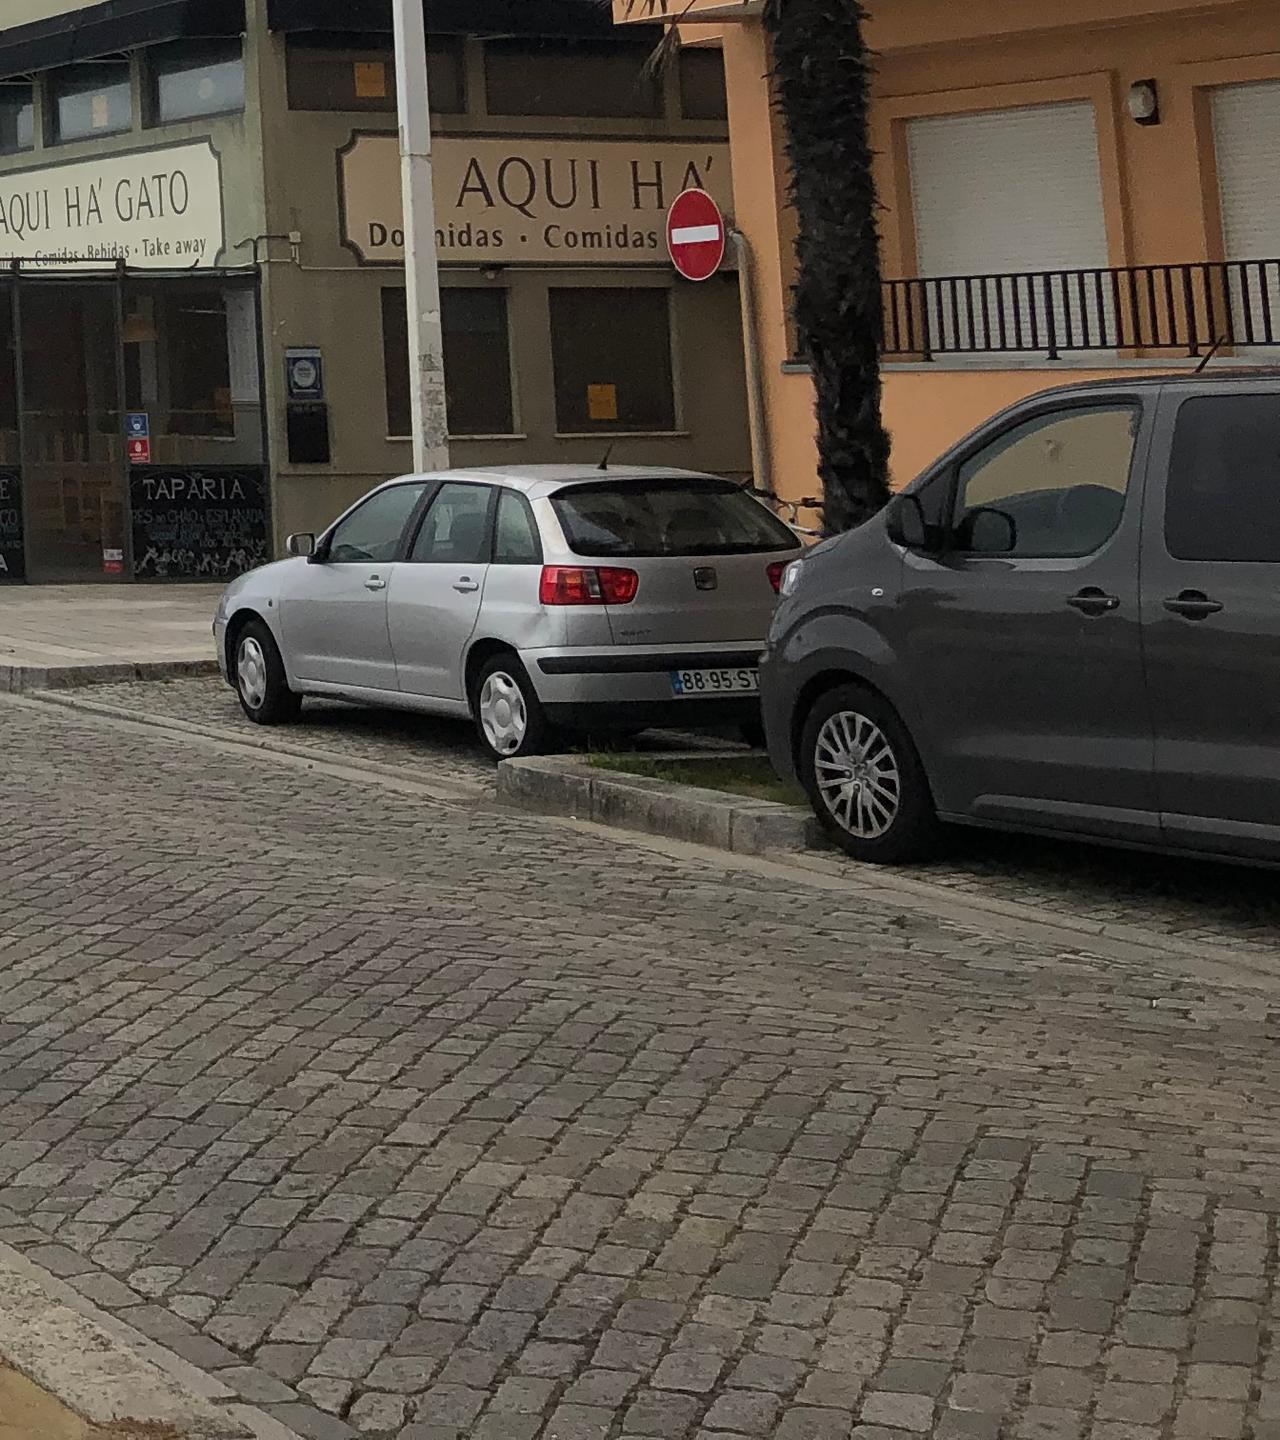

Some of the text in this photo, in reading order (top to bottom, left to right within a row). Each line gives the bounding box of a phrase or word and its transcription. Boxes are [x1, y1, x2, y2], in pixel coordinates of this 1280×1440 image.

[115, 170, 189, 222] GATO
[456, 157, 600, 218] AQUI
[142, 237, 170, 257] Take
[175, 238, 206, 257] away
[544, 224, 658, 249] Comidas
[142, 477, 246, 500] TAPARIA
